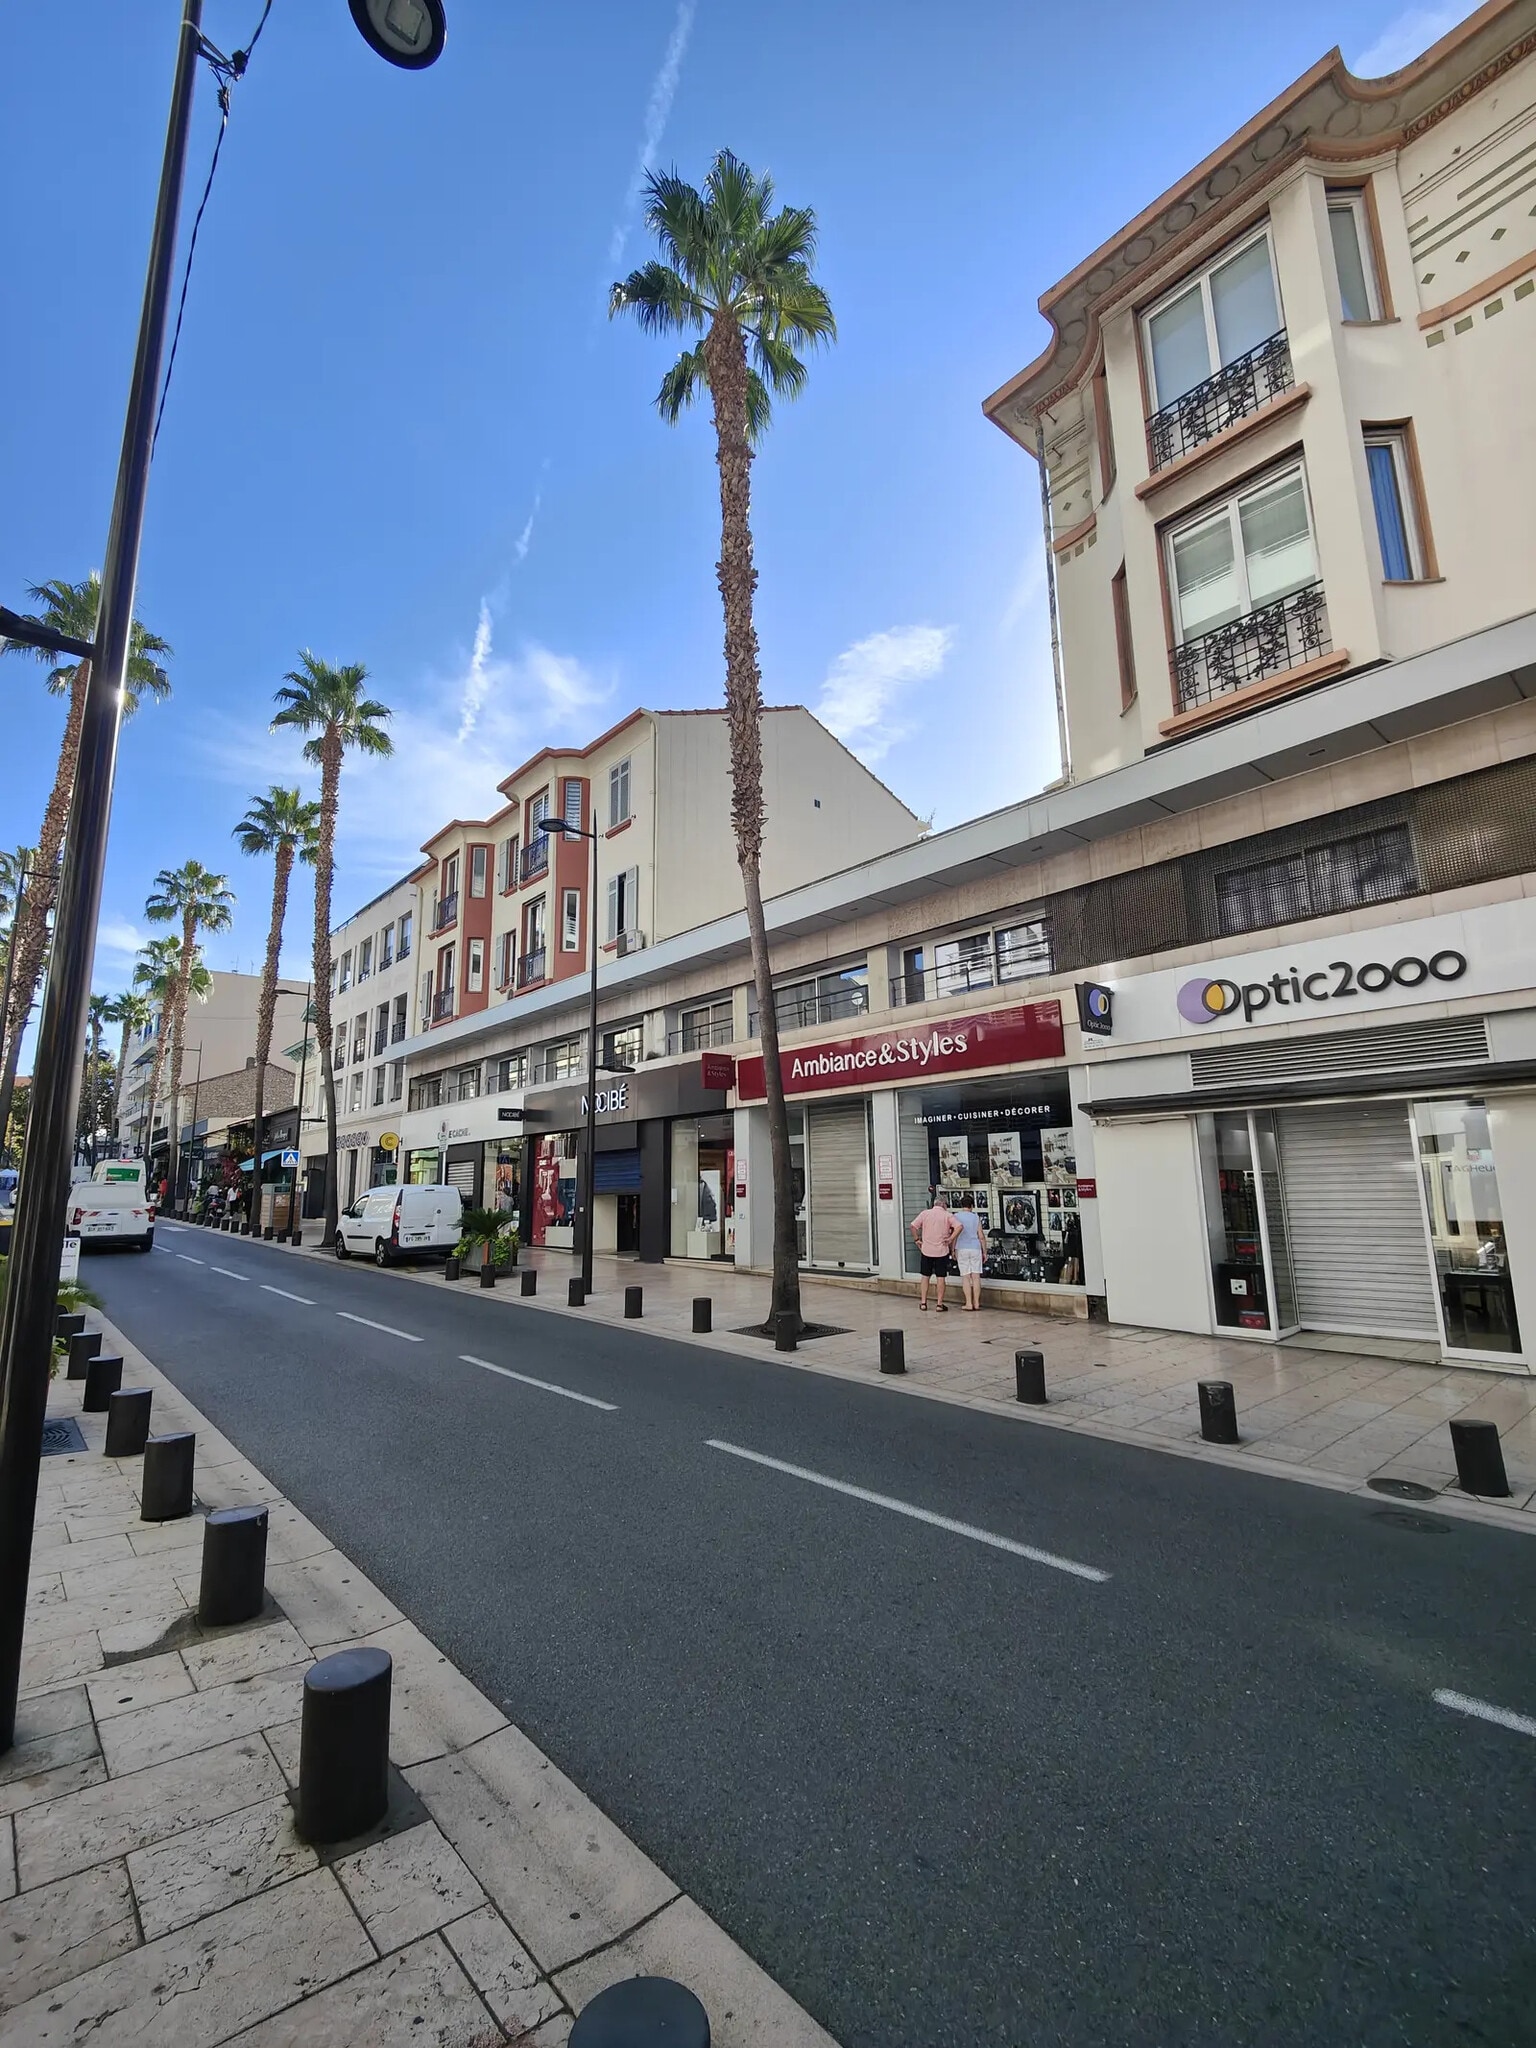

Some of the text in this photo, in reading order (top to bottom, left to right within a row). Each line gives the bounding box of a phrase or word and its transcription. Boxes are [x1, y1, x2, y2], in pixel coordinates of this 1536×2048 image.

[1201, 949, 1468, 1023] Optic2000
[914, 1105, 1051, 1125] IMAGINER CUISINER DÉCORER
